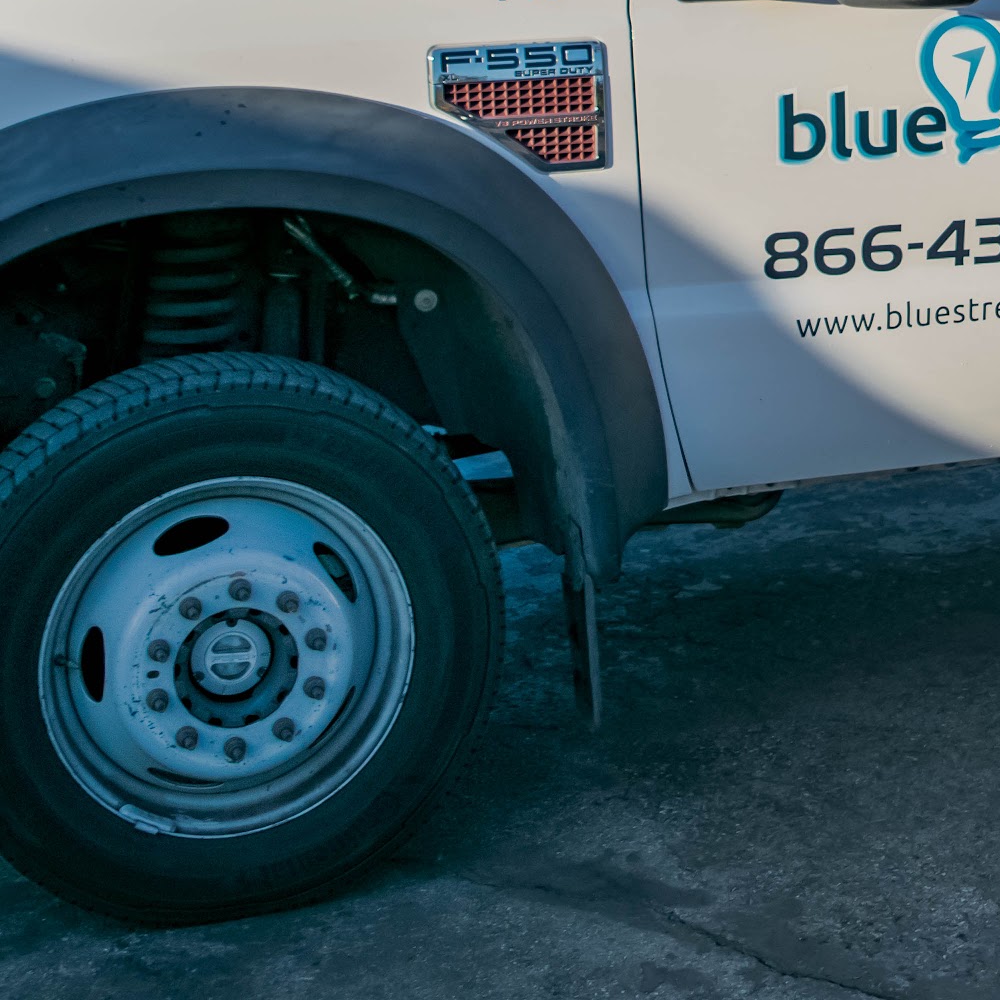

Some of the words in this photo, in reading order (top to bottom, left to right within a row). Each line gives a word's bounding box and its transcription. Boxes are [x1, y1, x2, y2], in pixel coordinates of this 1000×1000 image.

[514, 68, 556, 78] SUPER
[559, 66, 594, 75] DUTY
[778, 90, 947, 165] blue
